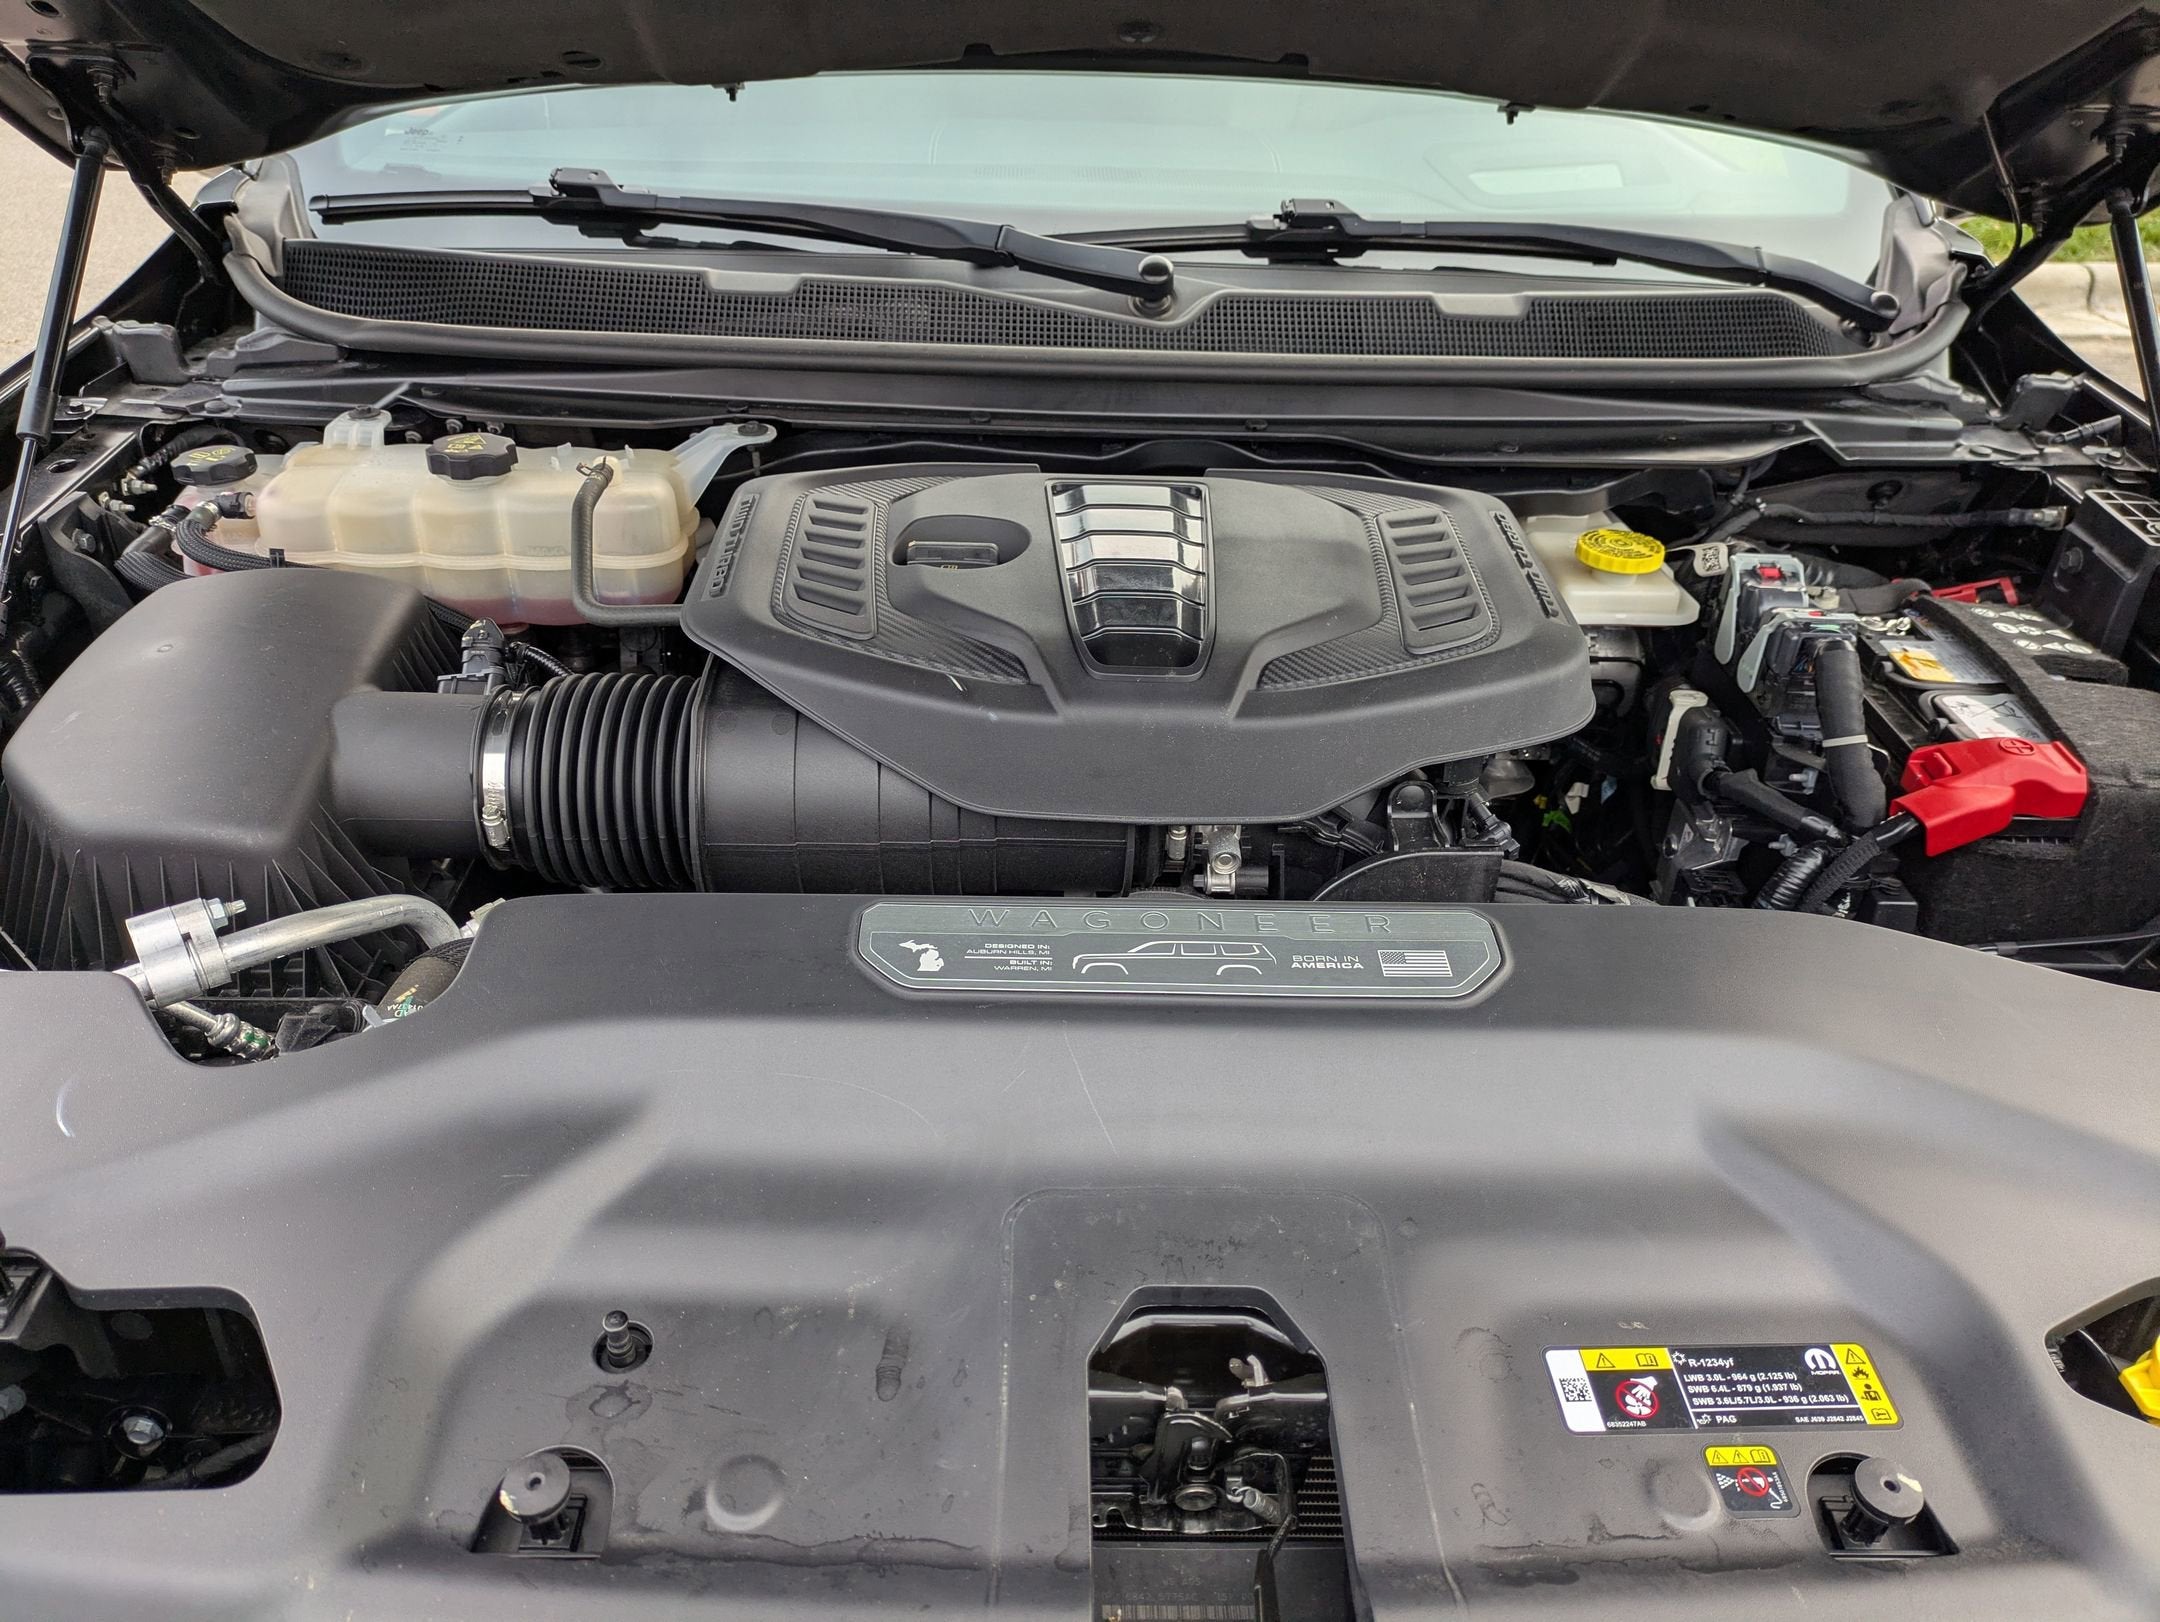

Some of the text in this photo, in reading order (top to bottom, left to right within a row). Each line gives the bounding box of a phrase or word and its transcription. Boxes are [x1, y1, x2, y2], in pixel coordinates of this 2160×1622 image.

[968, 909, 1392, 934] WAGONEER
[1688, 1357, 1735, 1369] R-1234yf
[1683, 1374, 1705, 1382] LWB
[1705, 1373, 1726, 1382] 3.0L
[1731, 1373, 1748, 1381] 964
[1749, 1374, 1756, 1382] g
[1757, 1372, 1784, 1381] (2.125
[1784, 1372, 1797, 1381] lb)
[1687, 1385, 1710, 1393] SWB
[1710, 1384, 1731, 1393] 6.4L
[1762, 1383, 1788, 1393] (1.937
[1789, 1383, 1803, 1392] lb)
[1692, 1397, 1715, 1406] SWB
[1782, 1395, 1800, 1404] 936
[1801, 1396, 1809, 1404] g
[1836, 1394, 1849, 1404] lb)
[1715, 1415, 1738, 1424] PAG
